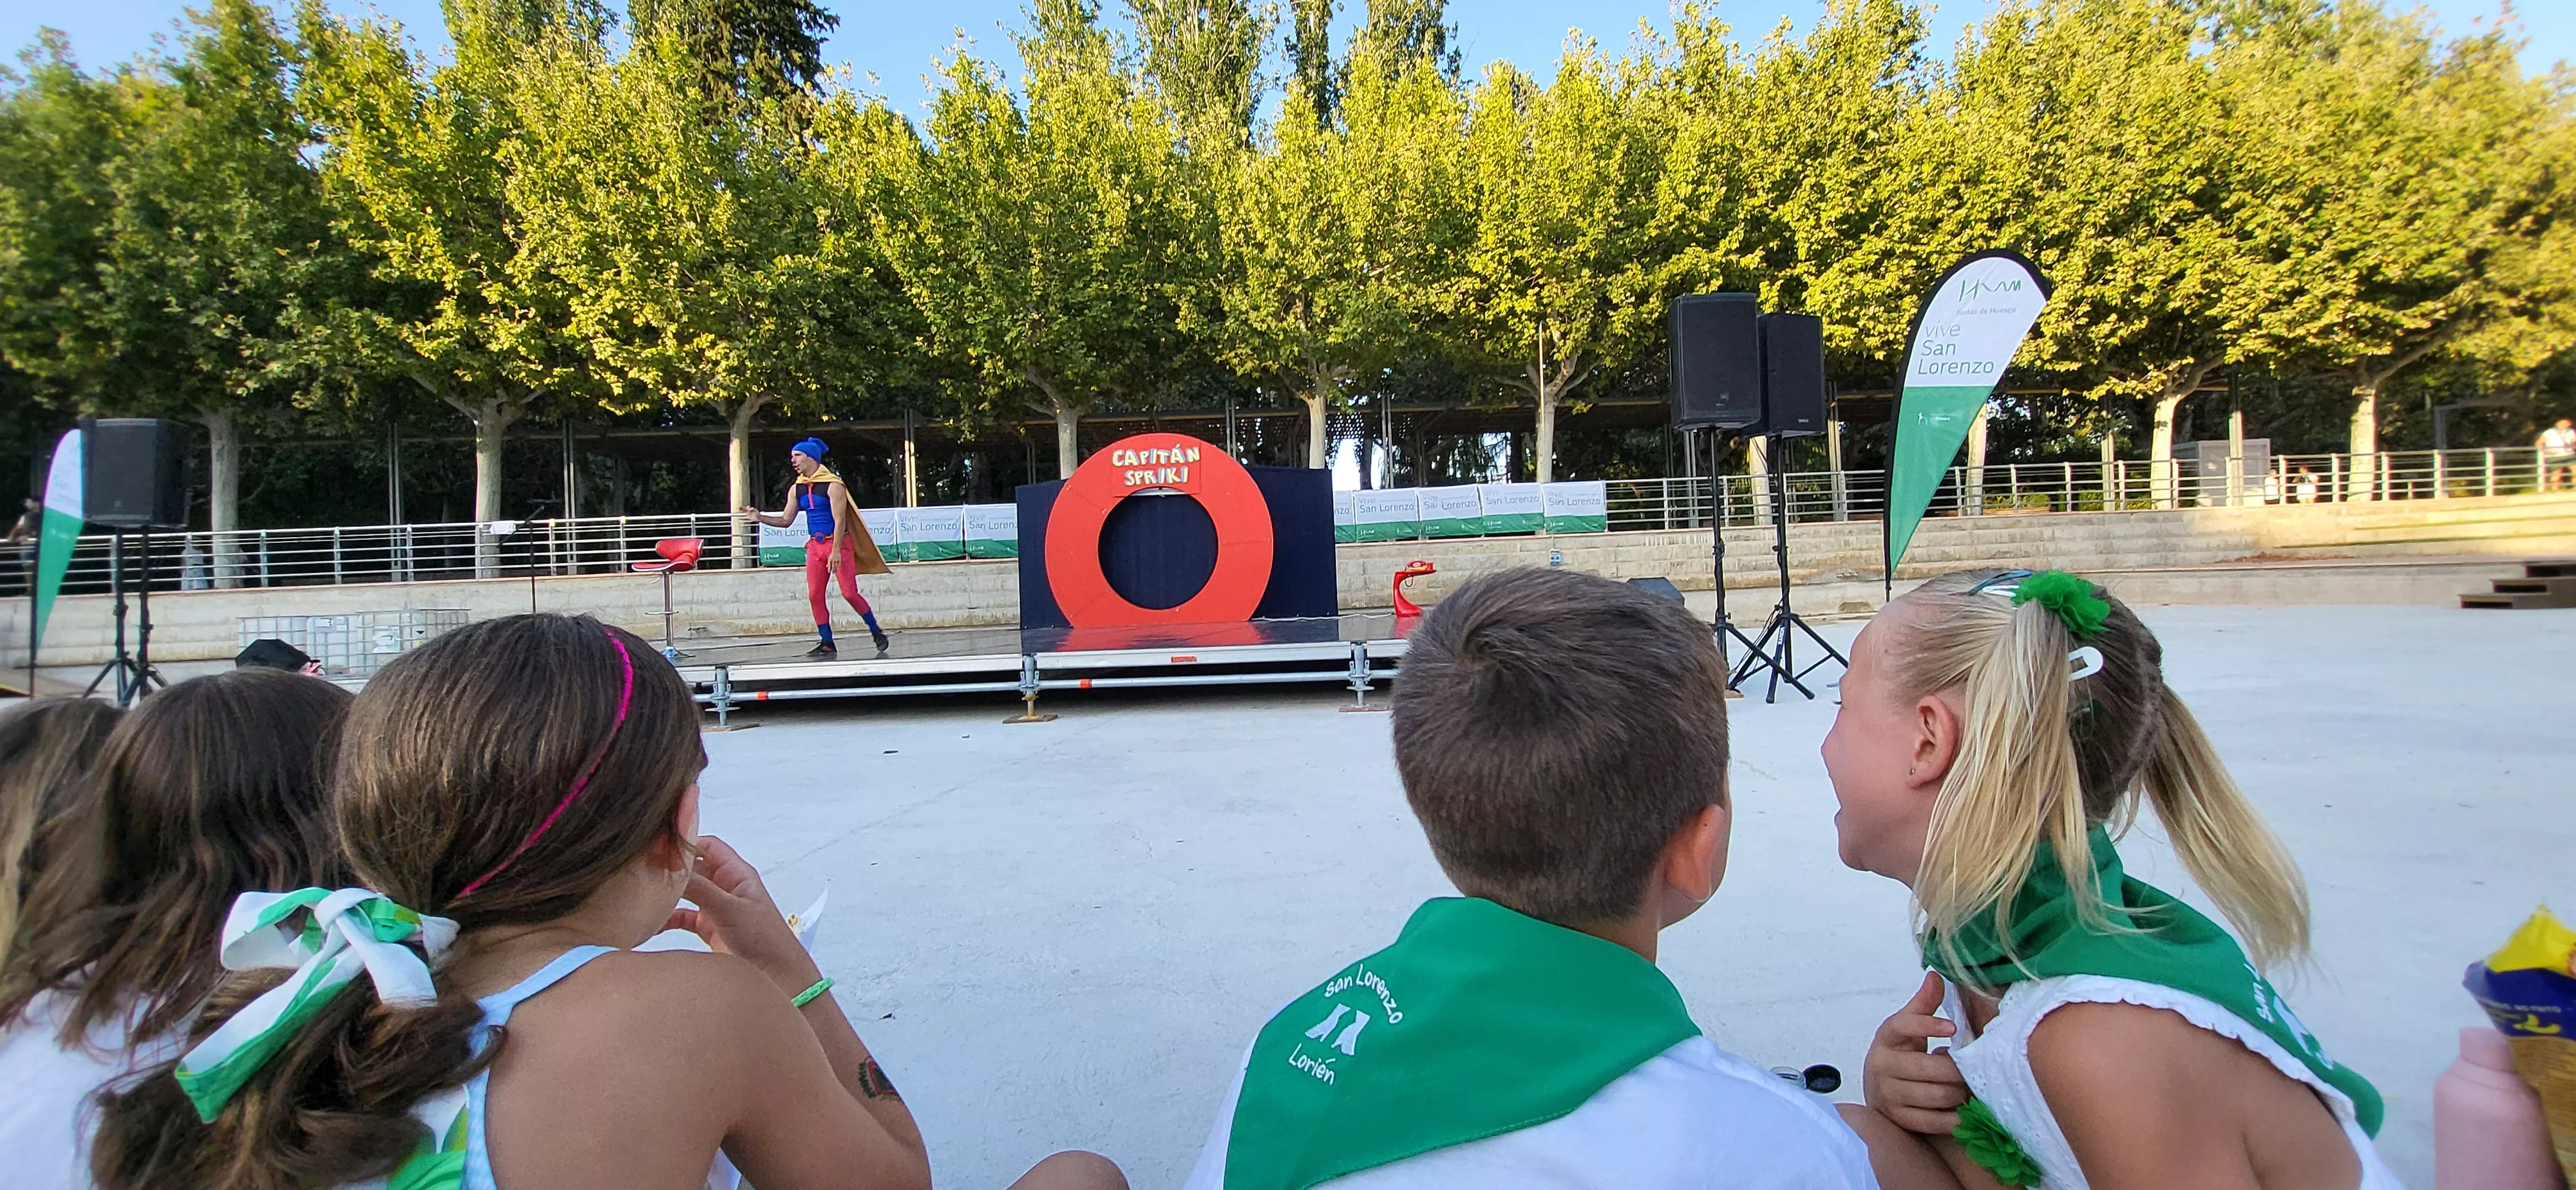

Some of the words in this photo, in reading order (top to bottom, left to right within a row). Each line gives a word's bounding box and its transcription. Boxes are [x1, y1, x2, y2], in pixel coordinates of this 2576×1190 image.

[1925, 321, 1960, 338] vive
[1922, 340, 1956, 355] San
[1918, 359, 1994, 375] Lorenzo
[1112, 443, 1200, 467] CAPITÁN
[1124, 466, 1189, 486] SPRIKI
[1442, 500, 1476, 510] Lorenzo
[1505, 495, 1539, 504] Lorenzo
[1548, 498, 1564, 506] San
[1567, 497, 1600, 506] Lorenzo
[1359, 504, 1376, 513] San
[1379, 504, 1414, 512] Lorenzo
[900, 523, 917, 532] San
[920, 522, 958, 531] Lorenzo
[969, 521, 985, 530] San
[989, 521, 1017, 530] Loren
[764, 528, 782, 536] San
[1355, 963, 1403, 1024] Lorenzo
[1288, 1043, 1336, 1086] Lorién
